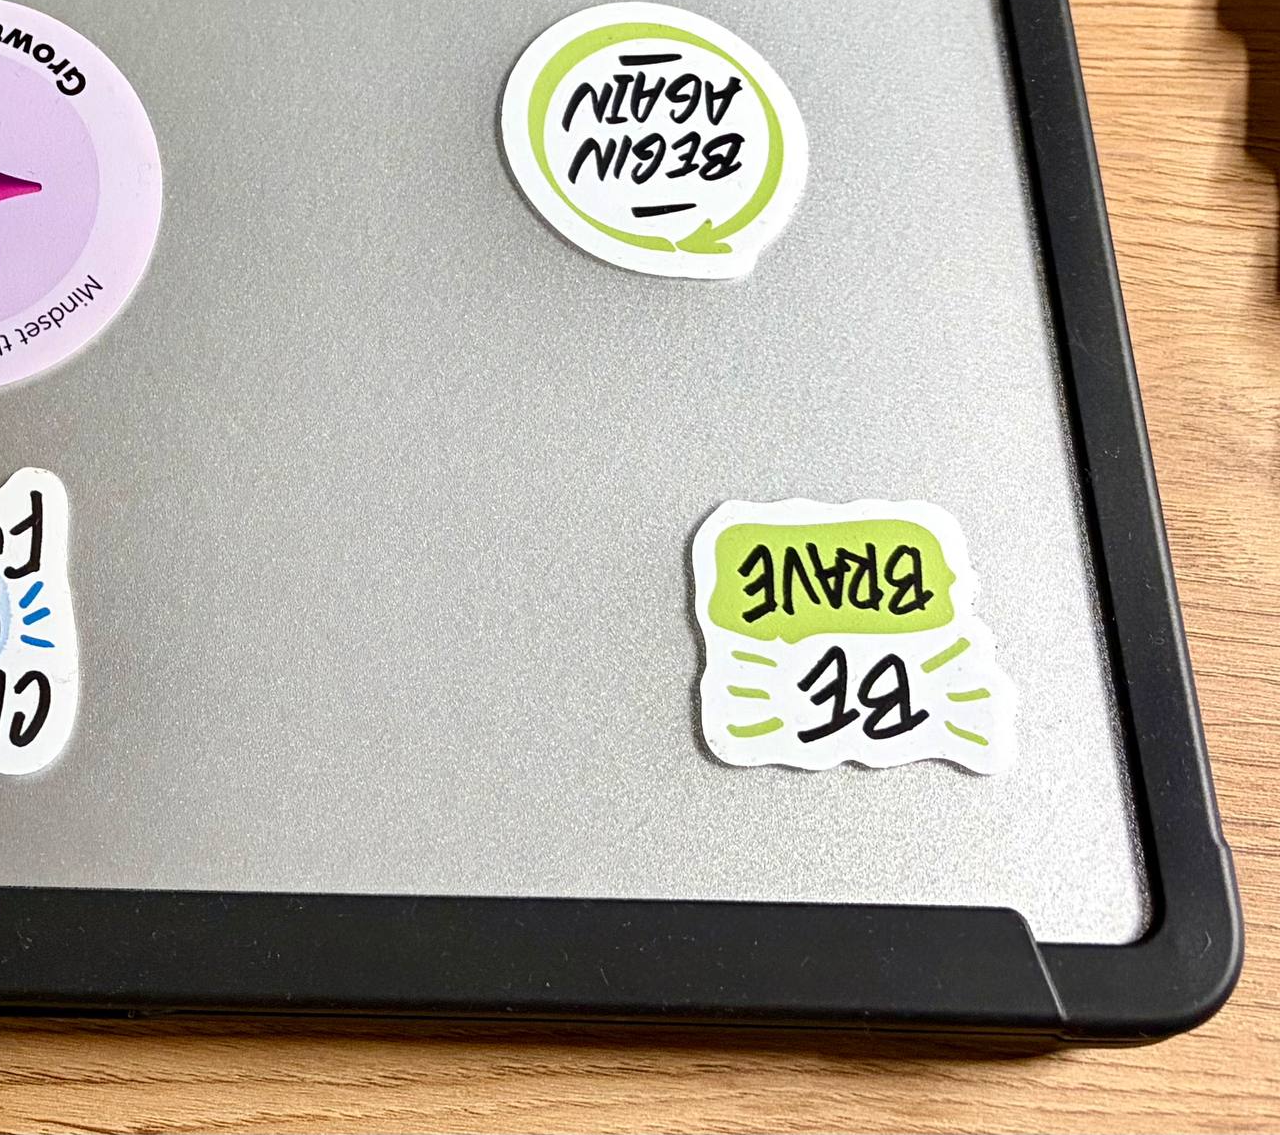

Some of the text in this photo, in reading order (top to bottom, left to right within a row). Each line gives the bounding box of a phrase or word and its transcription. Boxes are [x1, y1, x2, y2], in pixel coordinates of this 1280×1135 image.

[562, 71, 743, 132] AGAIN
[568, 131, 745, 185] BEGIN
[15, 275, 104, 344] Mindset
[737, 542, 934, 623] BRAVE
[797, 645, 930, 743] BE
